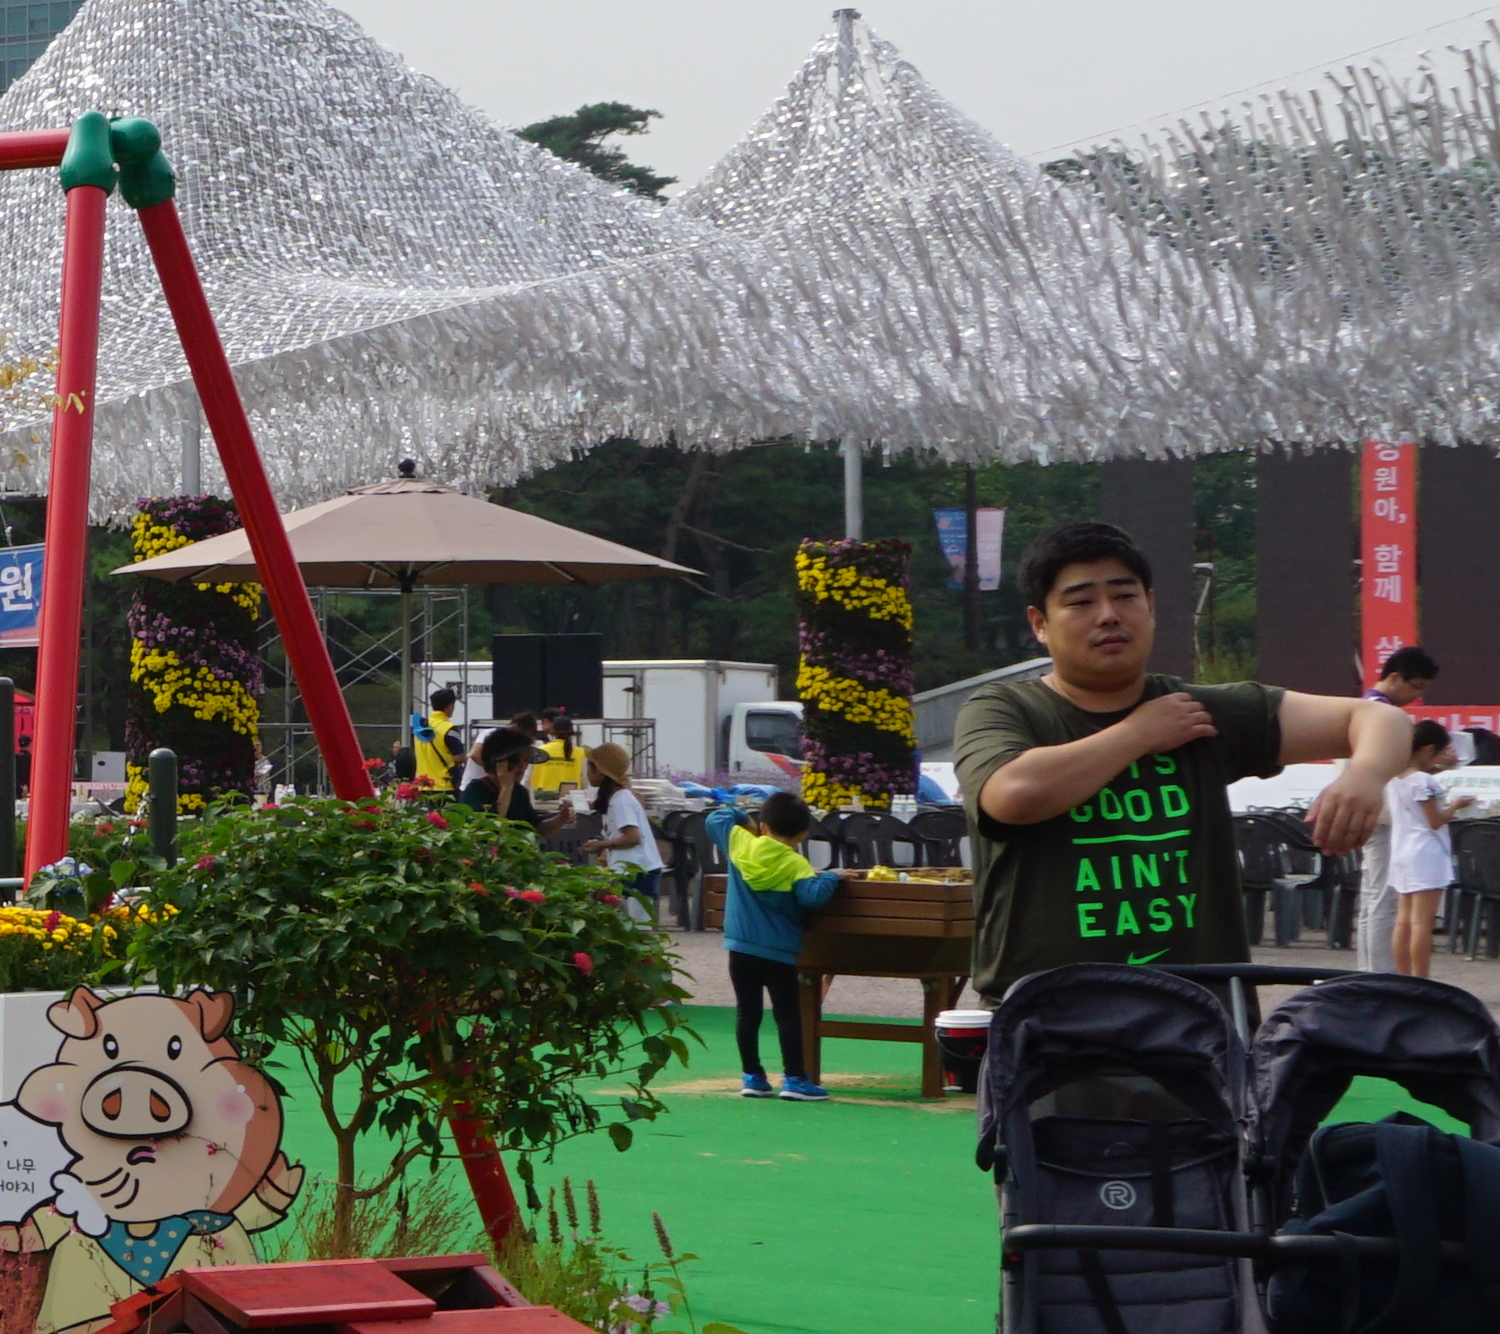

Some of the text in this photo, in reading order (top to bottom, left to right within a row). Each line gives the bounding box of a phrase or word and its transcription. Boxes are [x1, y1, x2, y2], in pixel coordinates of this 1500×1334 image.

[1373, 544, 1403, 603] 함께
[1076, 850, 1189, 892] AIN'T
[1078, 893, 1197, 938] EASY
[6, 1159, 36, 1174] 나무
